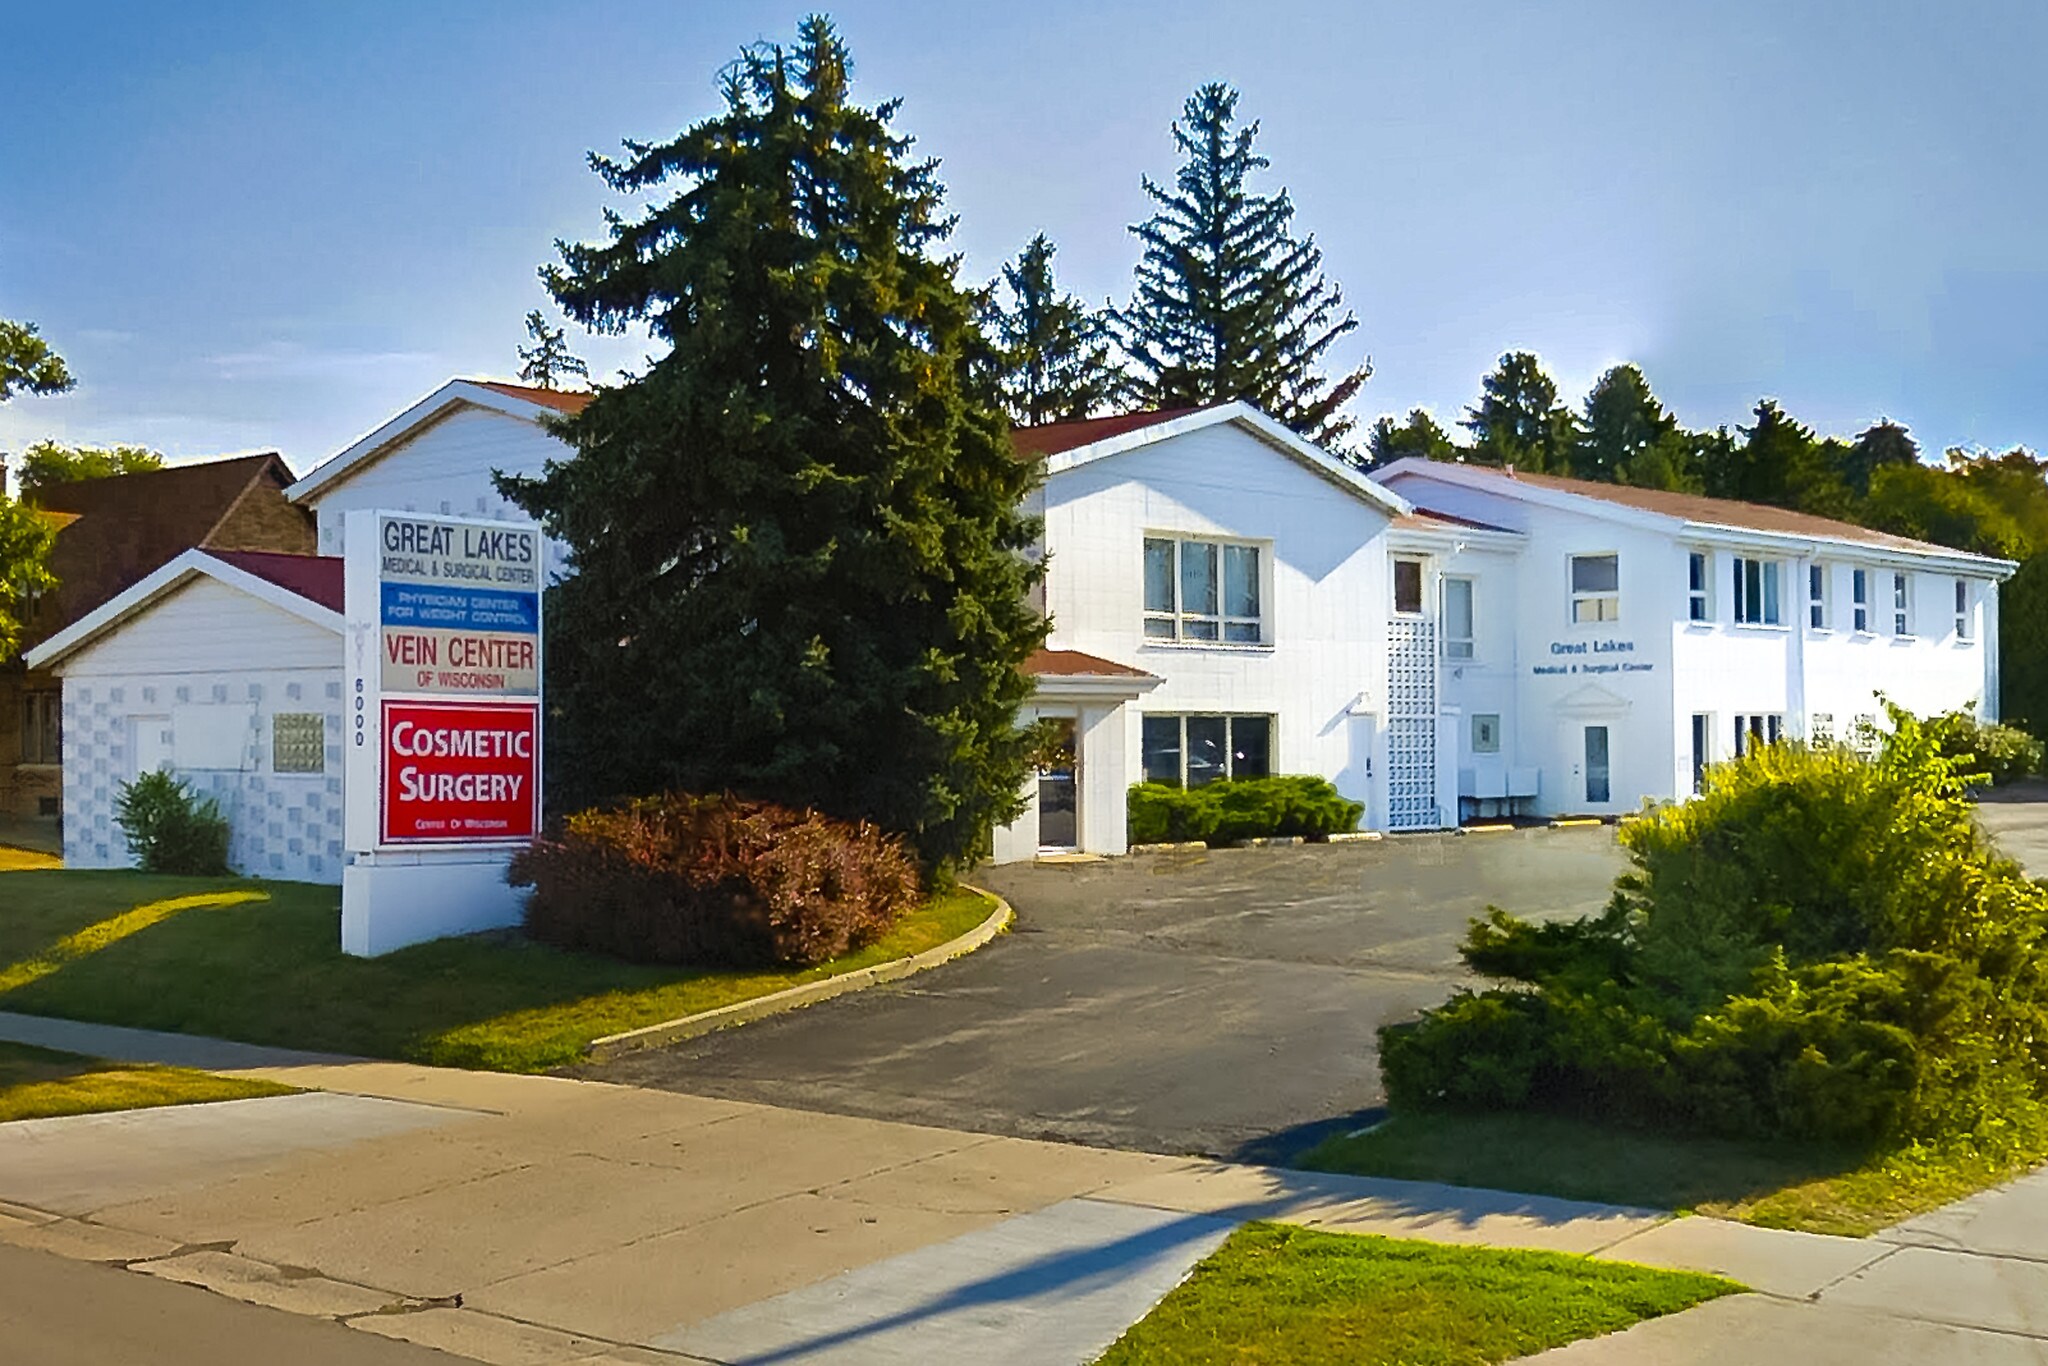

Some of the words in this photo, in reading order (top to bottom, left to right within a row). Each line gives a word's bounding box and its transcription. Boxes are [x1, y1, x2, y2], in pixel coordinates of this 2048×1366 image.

[384, 521, 454, 556] GREAT
[464, 529, 532, 563] LAKES
[382, 556, 426, 576] MEDICAL
[443, 561, 492, 581] SURGICAL
[496, 566, 535, 584] CENTER
[388, 606, 414, 618] FOR
[419, 608, 467, 622] WEIGHT
[472, 611, 528, 625] CONTROL
[471, 597, 519, 611] CENTER
[386, 634, 437, 666] VEIN
[448, 637, 534, 669] CENTER
[1551, 642, 1587, 654] Great
[1594, 639, 1634, 653] Lakes
[417, 671, 433, 687] OF
[438, 672, 505, 689] WISCONSIN
[1533, 664, 1567, 674] Medical
[1582, 663, 1619, 674] Surgical
[355, 678, 364, 746] 6000
[392, 721, 530, 758] COSMETIC
[400, 766, 523, 802] SURGERY
